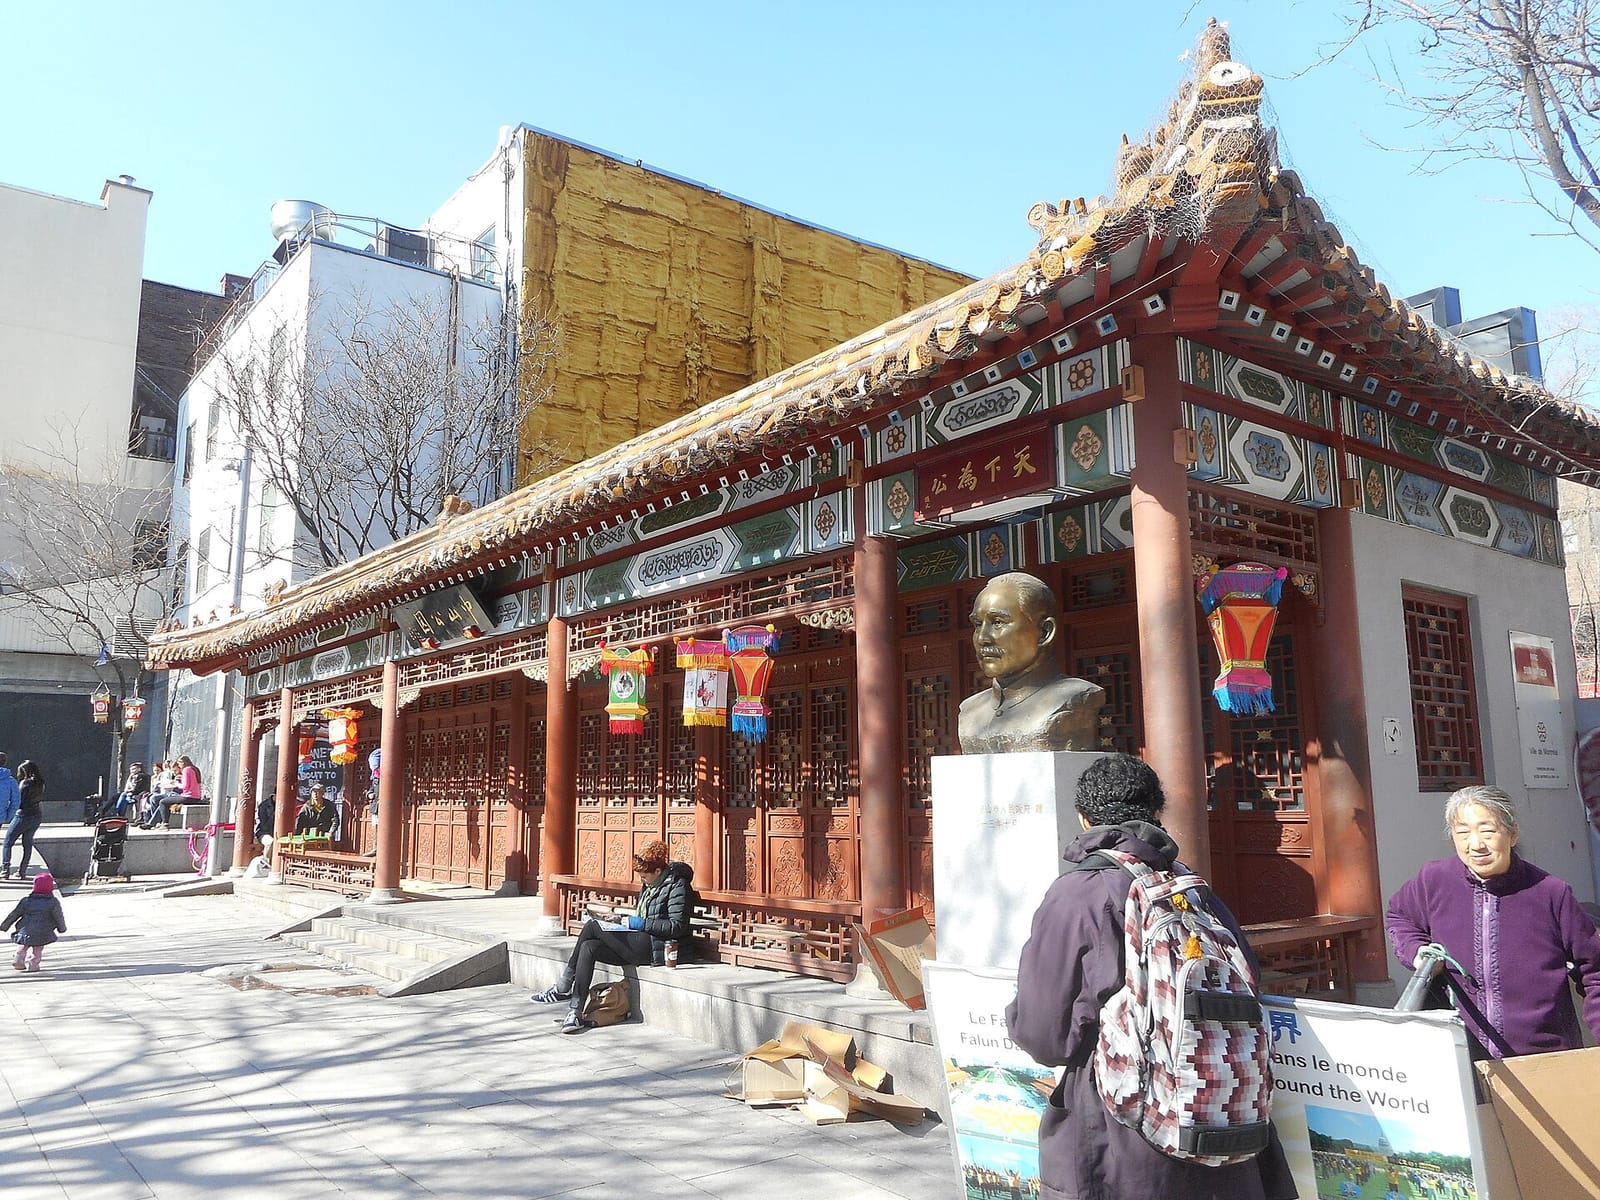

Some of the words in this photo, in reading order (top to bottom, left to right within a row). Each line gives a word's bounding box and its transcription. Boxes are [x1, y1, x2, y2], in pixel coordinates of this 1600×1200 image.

[931, 445, 1037, 496] 天下為公
[413, 594, 479, 635] 中山公園
[324, 771, 337, 780] TO
[968, 1011, 986, 1025] Le
[990, 1014, 1008, 1028] Fa
[1268, 1010, 1302, 1044] 界
[960, 1031, 999, 1049] Falun
[1274, 1052, 1307, 1068] ans
[1312, 1054, 1330, 1072] le
[1335, 1062, 1407, 1083] monde
[1275, 1078, 1324, 1097] ound
[1328, 1083, 1362, 1103] the
[1366, 1089, 1430, 1114] World
